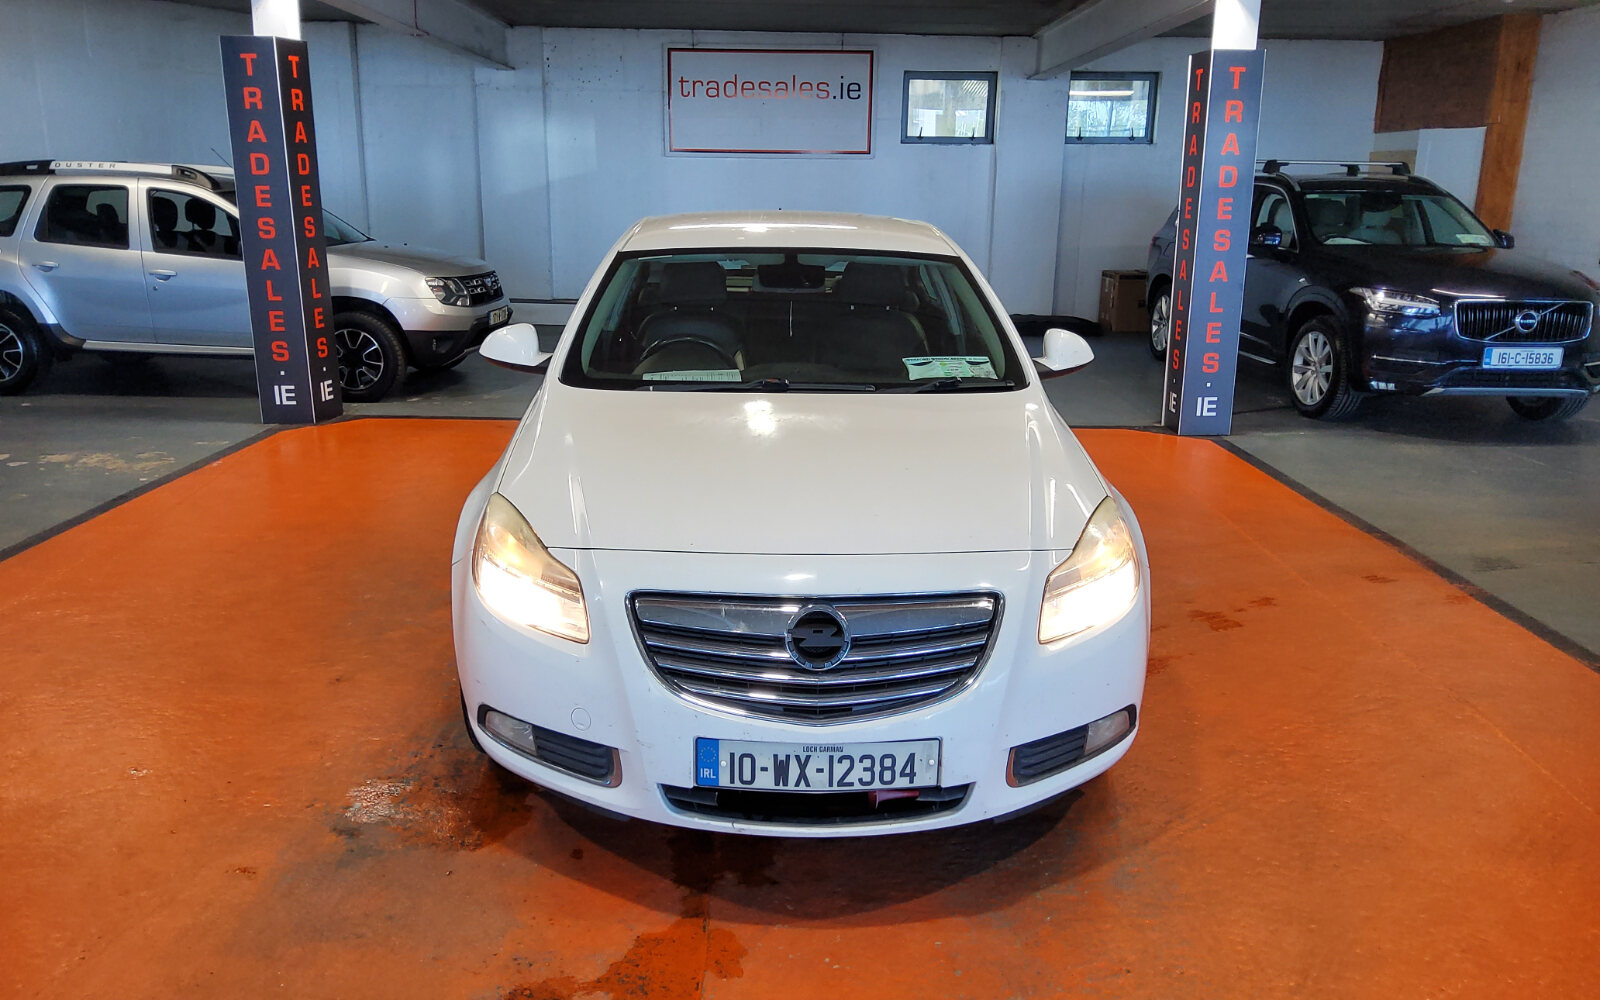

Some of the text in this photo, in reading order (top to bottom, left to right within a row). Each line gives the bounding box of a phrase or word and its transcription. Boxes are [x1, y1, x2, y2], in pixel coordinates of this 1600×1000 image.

[678, 74, 862, 100] tradesales.ie
[1497, 352, 1554, 364] 161-C-15836
[802, 745, 818, 753] LOCH
[700, 768, 717, 779] IRL
[729, 752, 917, 788] 10-WX-12384
